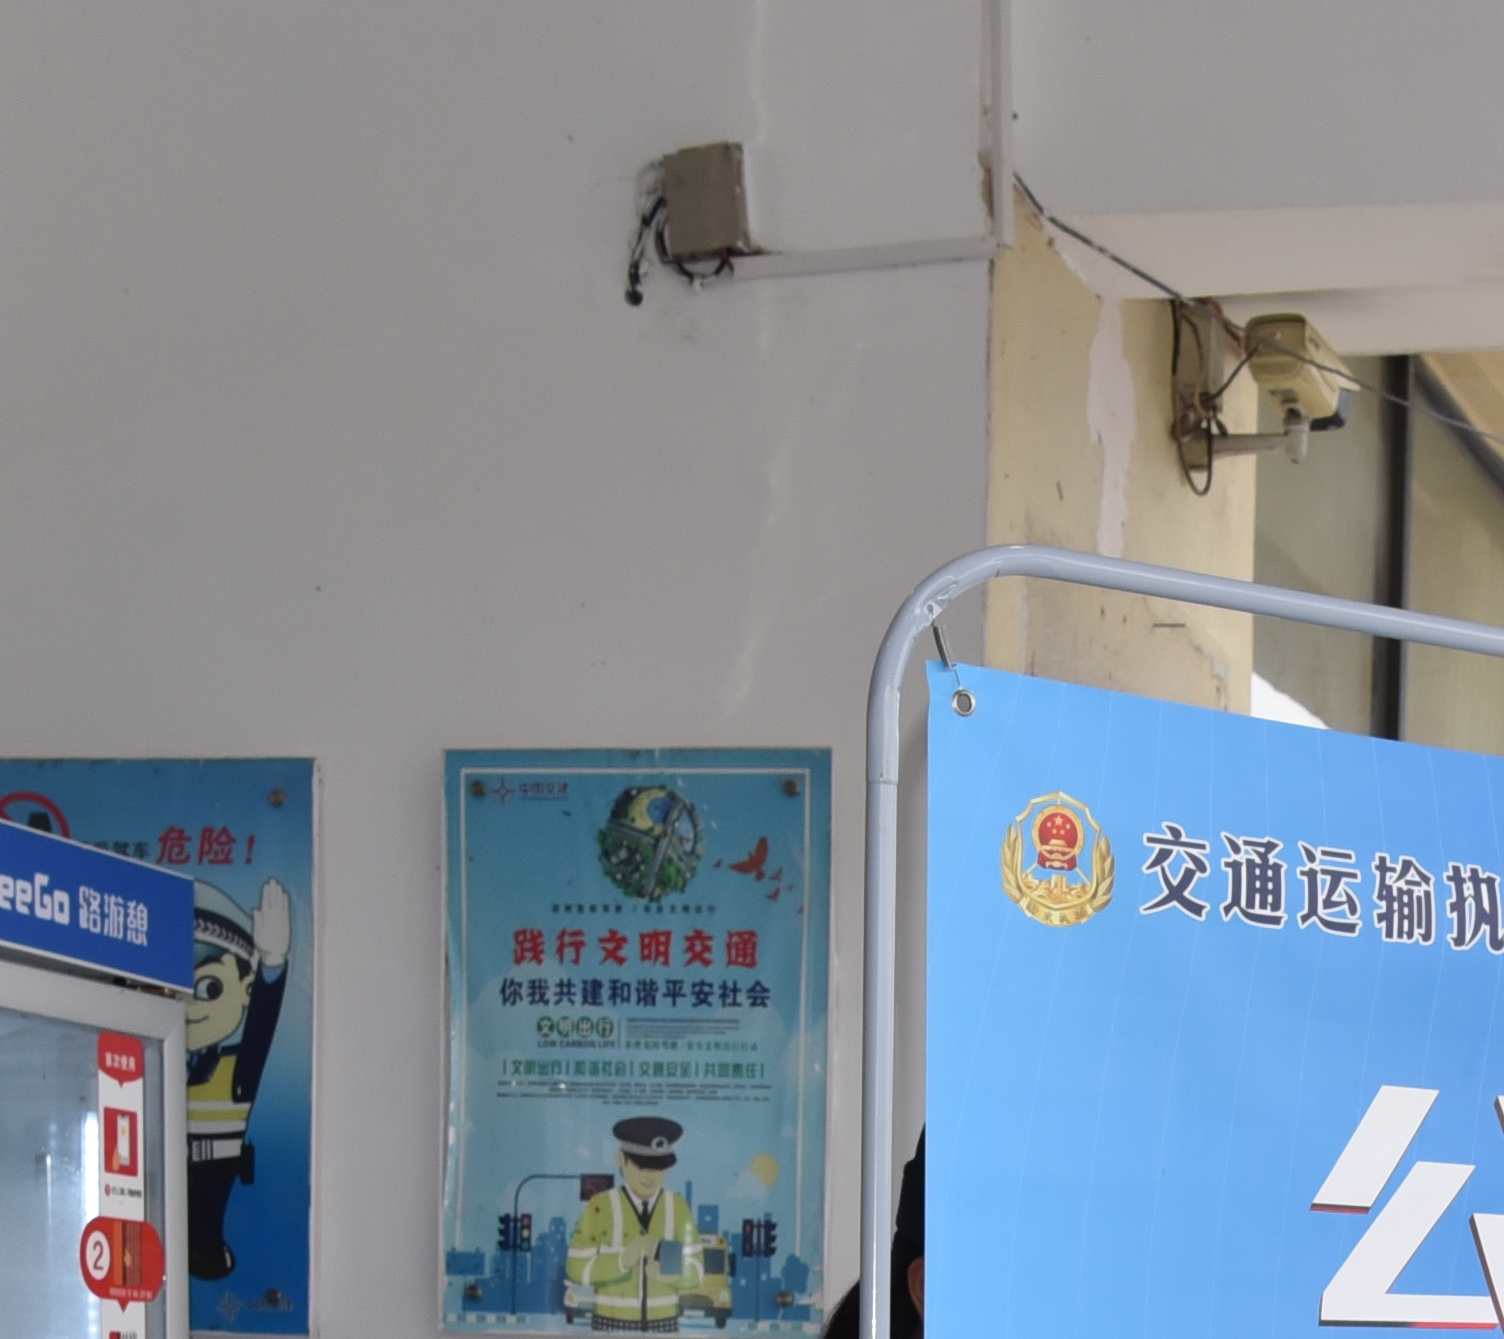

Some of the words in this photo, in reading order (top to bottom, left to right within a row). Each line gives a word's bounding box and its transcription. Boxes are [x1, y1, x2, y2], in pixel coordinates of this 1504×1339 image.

[79, 884, 150, 948] 路游憩
[513, 928, 758, 968] 践行文明交通
[500, 978, 772, 1008] 你我共建和谐平安社会
[538, 1017, 614, 1037] 文明出行
[511, 1057, 563, 1077] 文明出行
[638, 1059, 692, 1078] 交通安全
[92, 1240, 104, 1271] 2
